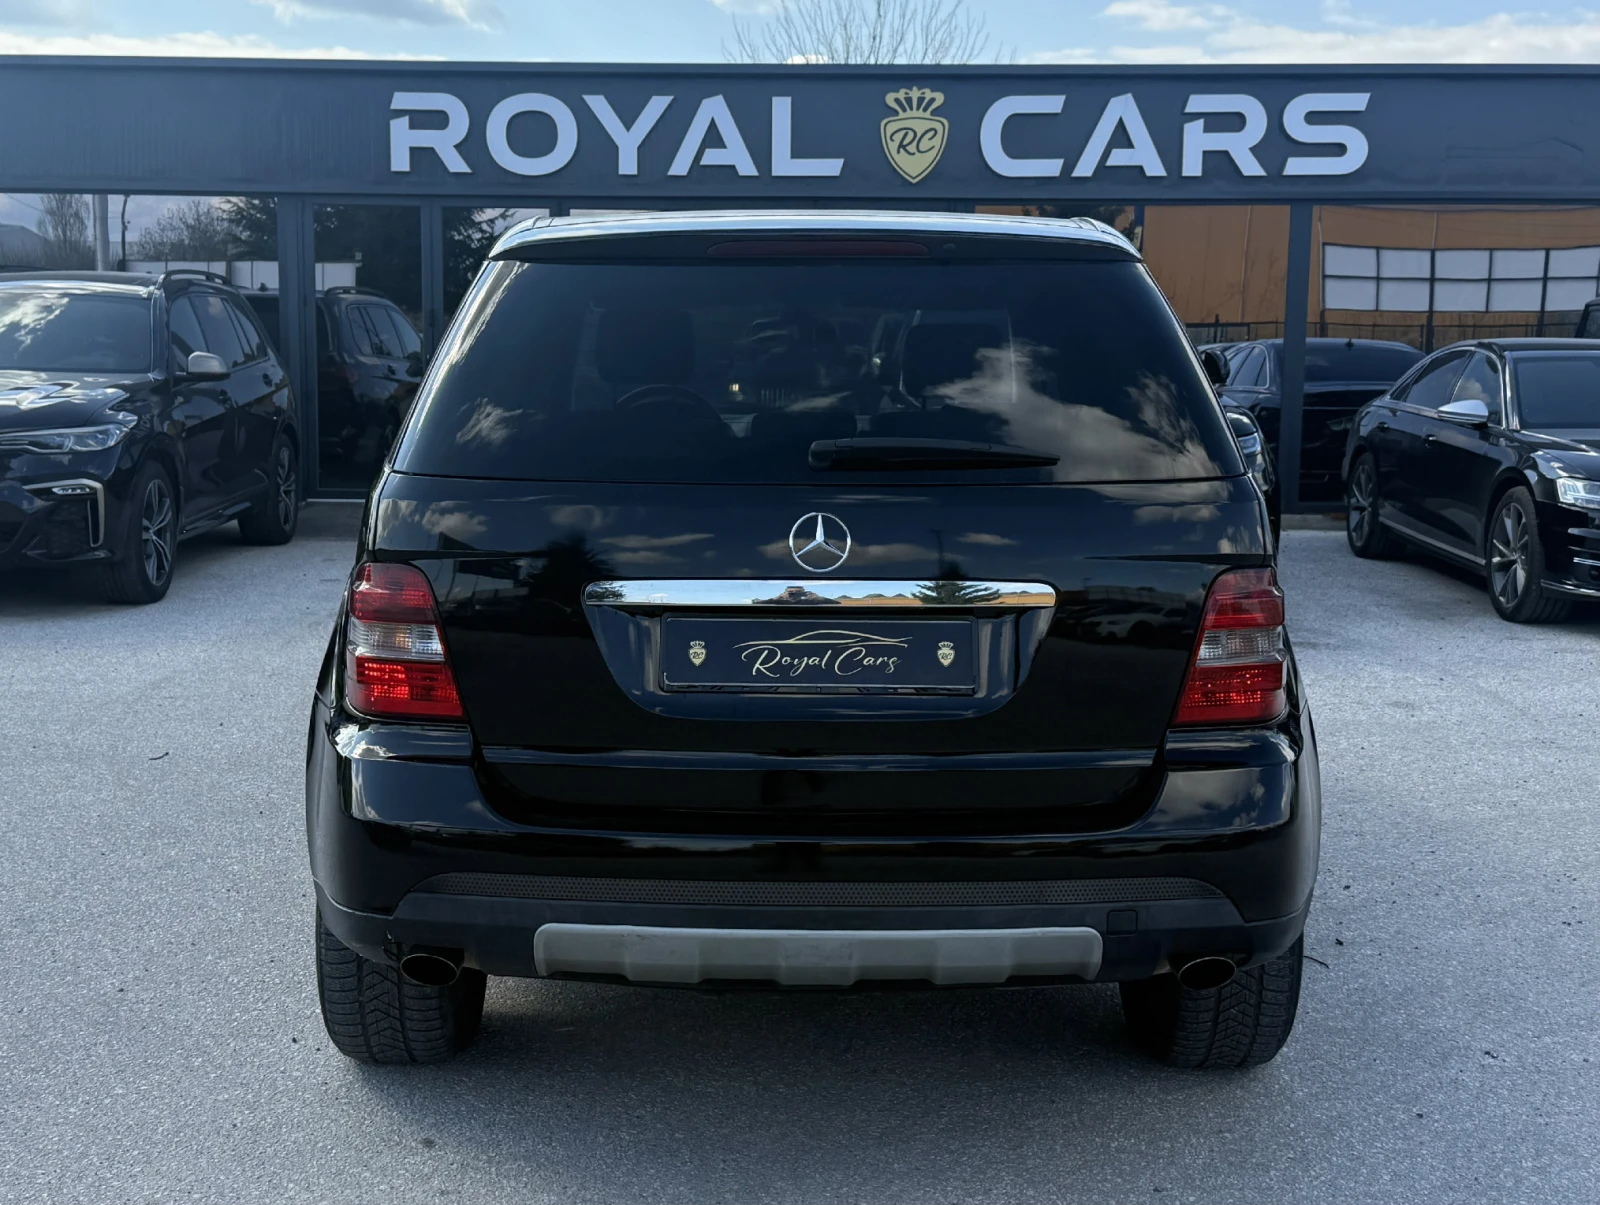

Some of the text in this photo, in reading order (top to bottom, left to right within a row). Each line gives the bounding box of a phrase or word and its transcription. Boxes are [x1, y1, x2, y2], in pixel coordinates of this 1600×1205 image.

[389, 91, 1371, 178] ROYAL CARS
[889, 126, 938, 155] RC
[741, 645, 903, 678] Royal Cars
